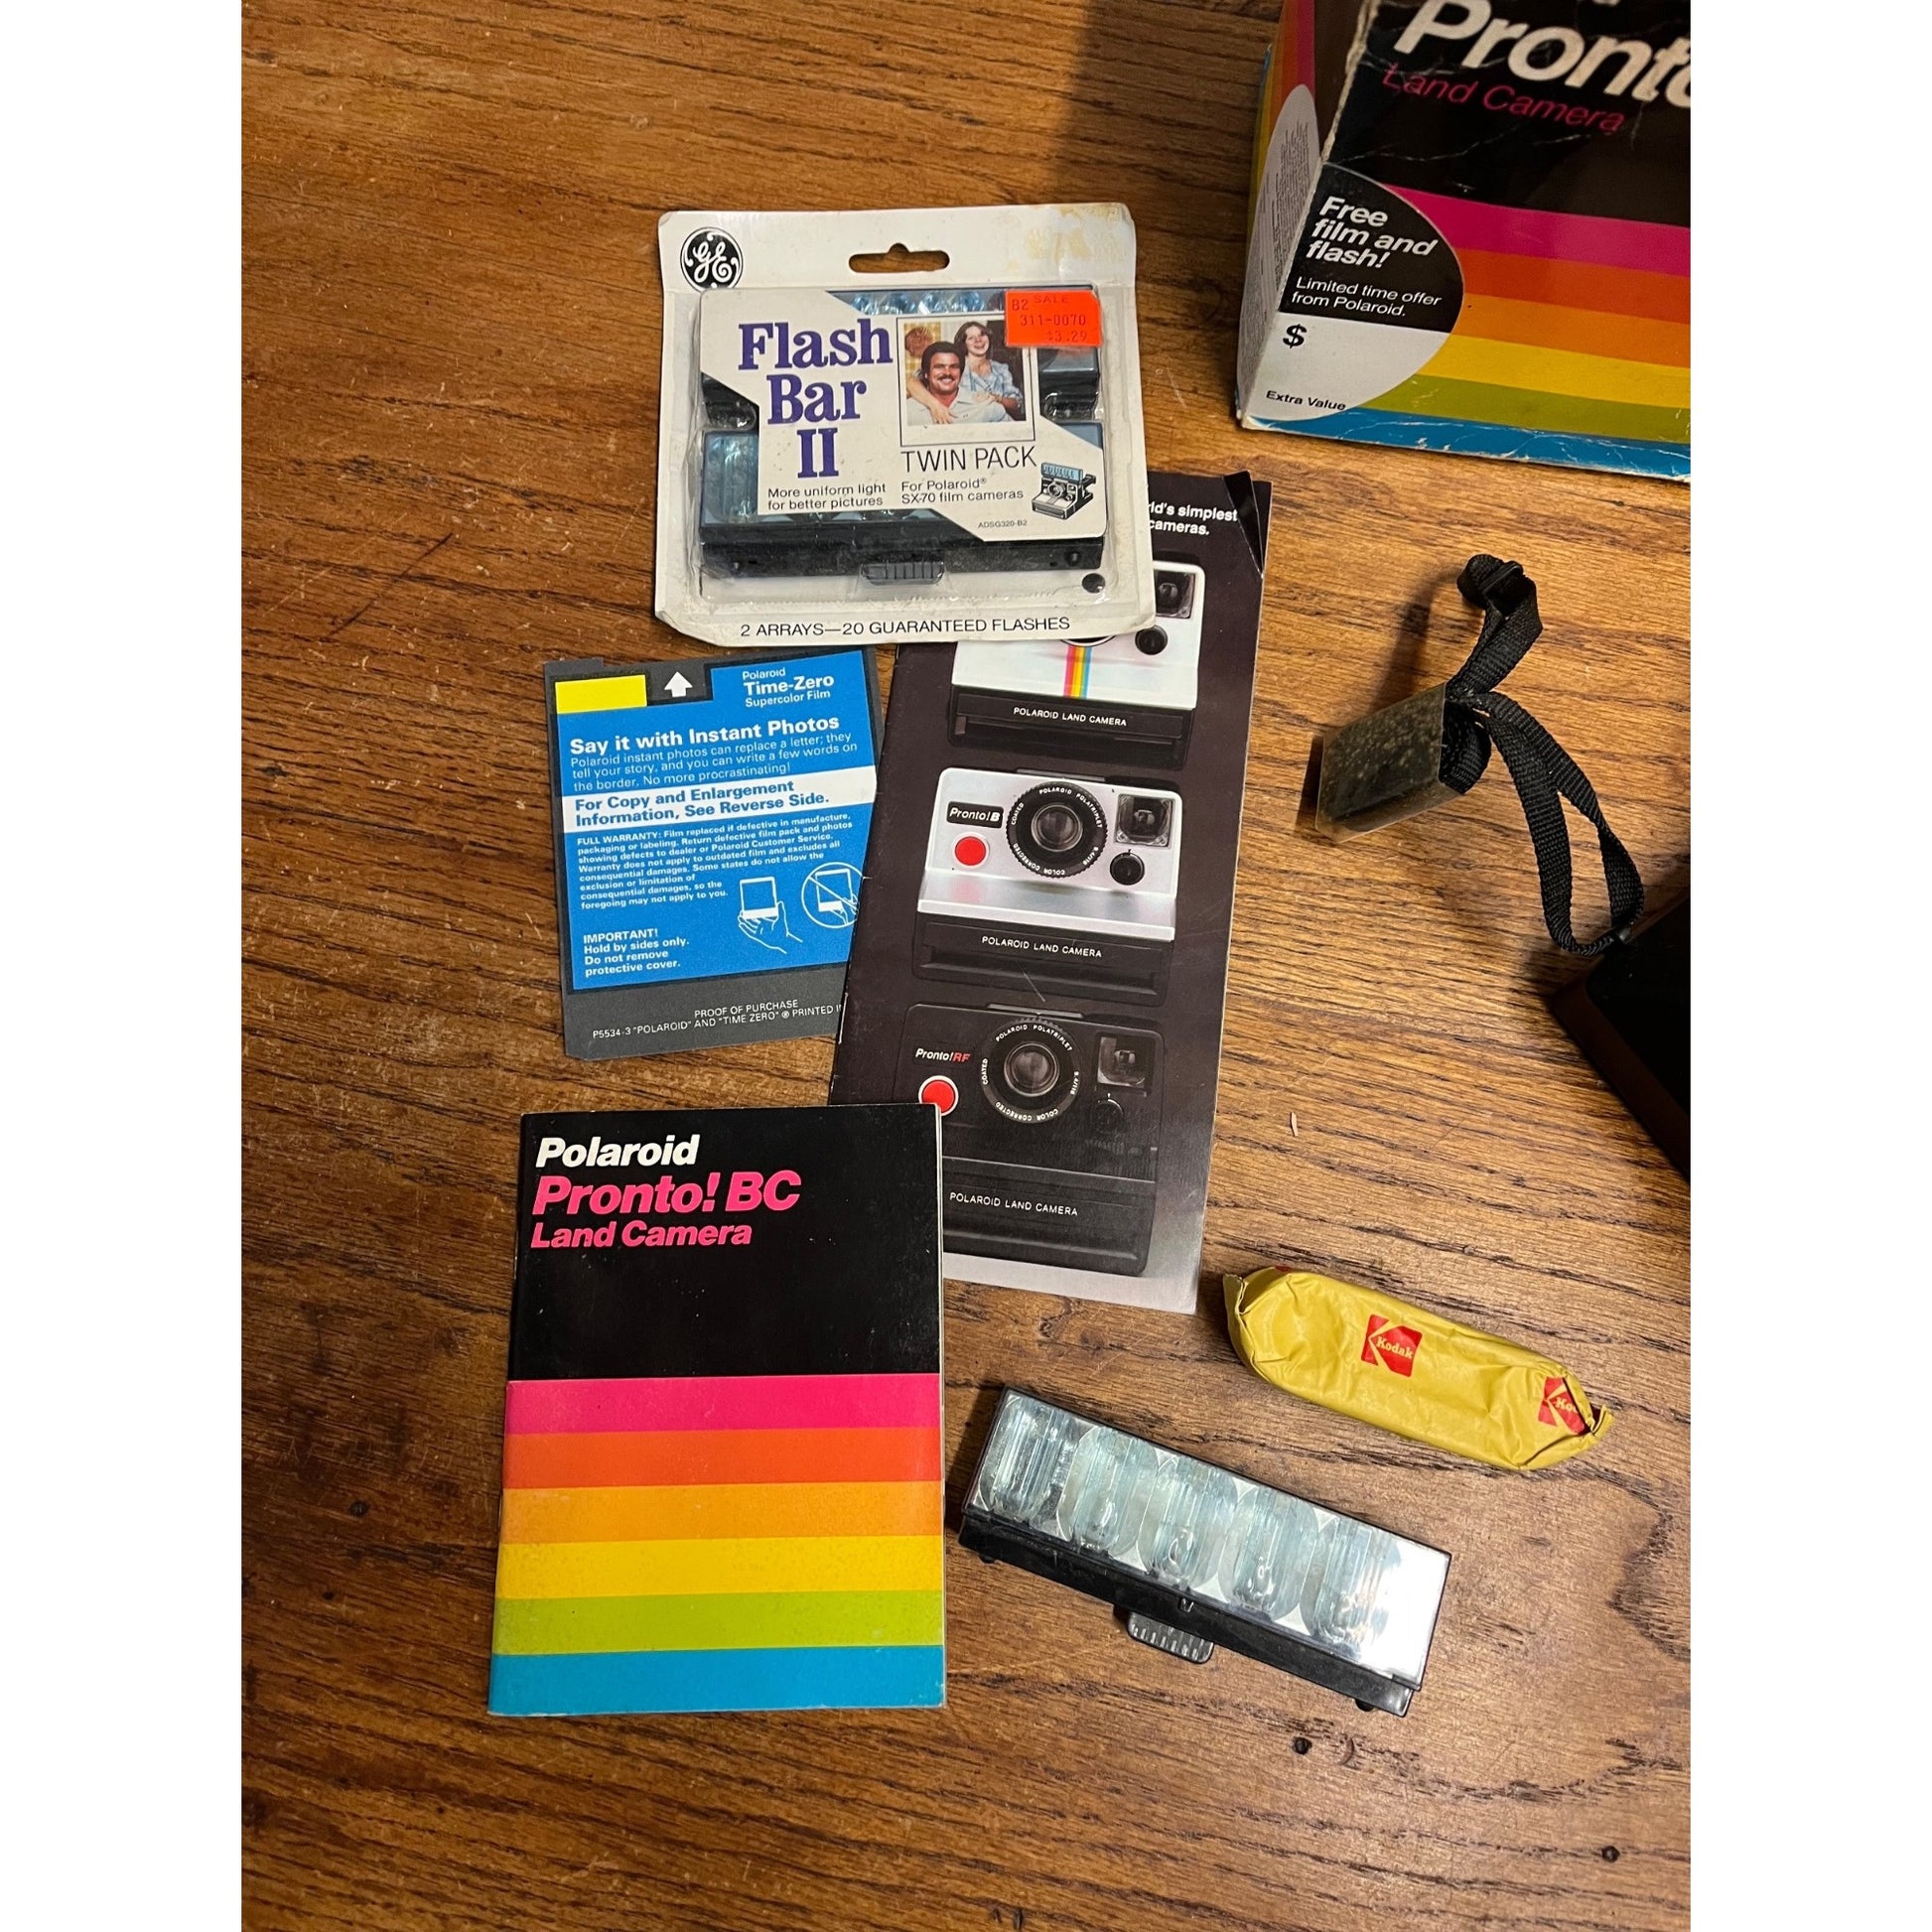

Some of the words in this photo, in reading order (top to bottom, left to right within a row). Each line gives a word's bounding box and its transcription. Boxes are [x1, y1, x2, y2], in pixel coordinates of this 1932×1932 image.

[1382, 63, 1478, 103] Land
[1483, 85, 1625, 133] Camera
[1318, 197, 1388, 227] Free
[1311, 219, 1369, 247] film
[1375, 235, 1438, 257] and
[1306, 240, 1391, 269] flash!
[1034, 295, 1069, 304] SALE
[1297, 276, 1358, 296] Limited
[1361, 284, 1399, 301] time
[1402, 290, 1442, 306] offer
[1013, 299, 1029, 311] B2
[1292, 292, 1329, 308] from
[1333, 296, 1407, 318] Polaroid.
[1020, 314, 1086, 326] 311-0070
[738, 318, 893, 371] Flash
[1047, 331, 1087, 343] $3.29
[1283, 324, 1308, 349] $
[766, 374, 868, 425] Bar
[1266, 389, 1303, 406] Extra
[1308, 397, 1346, 411] Value
[796, 427, 840, 479] II
[900, 449, 966, 474] TWIN
[975, 445, 1037, 470] PACK
[767, 487, 800, 497] More
[803, 485, 854, 496] uniform
[858, 483, 886, 495] light
[901, 481, 922, 491] For
[901, 491, 936, 504] SX-70
[939, 491, 963, 502] film
[967, 490, 1024, 500] cameras
[767, 496, 785, 510] for
[788, 495, 827, 509] better
[830, 492, 883, 510] pictures
[1177, 504, 1237, 521] simplest
[1149, 520, 1209, 535] cameras.
[741, 623, 751, 636] 2
[869, 619, 987, 634] GUARANTEED
[992, 616, 1070, 631] FLASHES
[742, 666, 786, 680] Polaroid
[743, 675, 834, 696] Time-Zero
[745, 693, 804, 708] Supercolor
[806, 689, 831, 700] Film
[1013, 707, 1059, 719] POLAROID
[1061, 712, 1086, 722] LAND
[1088, 715, 1127, 726] CAMERA
[570, 739, 609, 759] Say
[615, 735, 630, 751] it
[635, 730, 683, 749] with
[689, 724, 761, 744] Instant
[767, 717, 839, 737] Photos
[570, 754, 621, 767] Polaroid
[623, 751, 663, 762] instant
[666, 748, 708, 761] photos
[710, 746, 732, 756] can
[735, 741, 777, 754] replace
[779, 740, 787, 749] a
[790, 736, 823, 747] letter;
[825, 733, 851, 746] they
[572, 768, 591, 778] tell
[594, 767, 621, 778] your
[624, 763, 657, 774] story,
[660, 759, 683, 770] and
[686, 759, 709, 770] you
[711, 757, 733, 766] can
[735, 752, 765, 763] write
[778, 749, 800, 759] few
[802, 744, 839, 757] words
[842, 744, 858, 753] on
[573, 781, 593, 791] the
[596, 777, 639, 789] border.
[642, 774, 660, 785] No
[663, 773, 695, 783] more
[698, 761, 790, 782] procrastinating!
[575, 799, 603, 811] For
[607, 796, 650, 809] Copy
[655, 789, 685, 804] and
[690, 780, 794, 801] Enlargement
[576, 808, 679, 827] Information,
[684, 804, 715, 817] See
[719, 798, 784, 814] Reverse
[788, 792, 829, 806] Side.
[1011, 802, 1025, 825] COATED
[1076, 793, 1103, 828] POLATRIPLET
[577, 836, 601, 845] FULL
[602, 831, 661, 843] WARRANTY:
[663, 829, 684, 838] Film
[686, 825, 725, 836] replaced
[736, 820, 777, 831] defective
[790, 813, 851, 825] manufacture,
[577, 844, 625, 858] packaging
[639, 840, 679, 849] labeling.
[714, 832, 756, 842] defective
[758, 829, 776, 838] film
[778, 826, 800, 837] pack
[802, 824, 819, 833] and
[821, 821, 853, 833] photos
[1013, 843, 1040, 871] CORRECTED
[583, 927, 658, 944] IMPORTANT!
[584, 943, 611, 954] Hold
[613, 942, 627, 953] by
[629, 939, 659, 950] sides
[661, 936, 689, 947] only.
[981, 935, 1030, 949] POLAROID
[1033, 942, 1059, 953] LAND
[1061, 945, 1102, 957] CAMERA
[584, 956, 602, 965] Do
[604, 953, 623, 963] not
[625, 950, 668, 961] remove
[585, 963, 642, 978] protective
[645, 960, 681, 970] cover.
[693, 1018, 716, 1028] AND
[791, 1005, 834, 1018] PRINTED
[694, 1007, 727, 1019] PROOF
[730, 1005, 743, 1016] OF
[746, 999, 798, 1014] PURCHASE
[996, 1025, 1028, 1042] POLAROID
[1034, 1024, 1073, 1051] POLATRIPLET
[996, 1101, 1033, 1121] CORRECTED
[1036, 1108, 1059, 1121] COLOR
[535, 1134, 701, 1168] Polaroid
[532, 1172, 721, 1215] Pronto!
[725, 1170, 802, 1211] BC
[949, 1191, 1001, 1206] POLAROID
[1005, 1199, 1032, 1210] LAND
[1035, 1202, 1078, 1216] CAMERA
[530, 1220, 616, 1249] Land
[621, 1219, 753, 1247] Camera
[1376, 1335, 1414, 1360] Kodak
